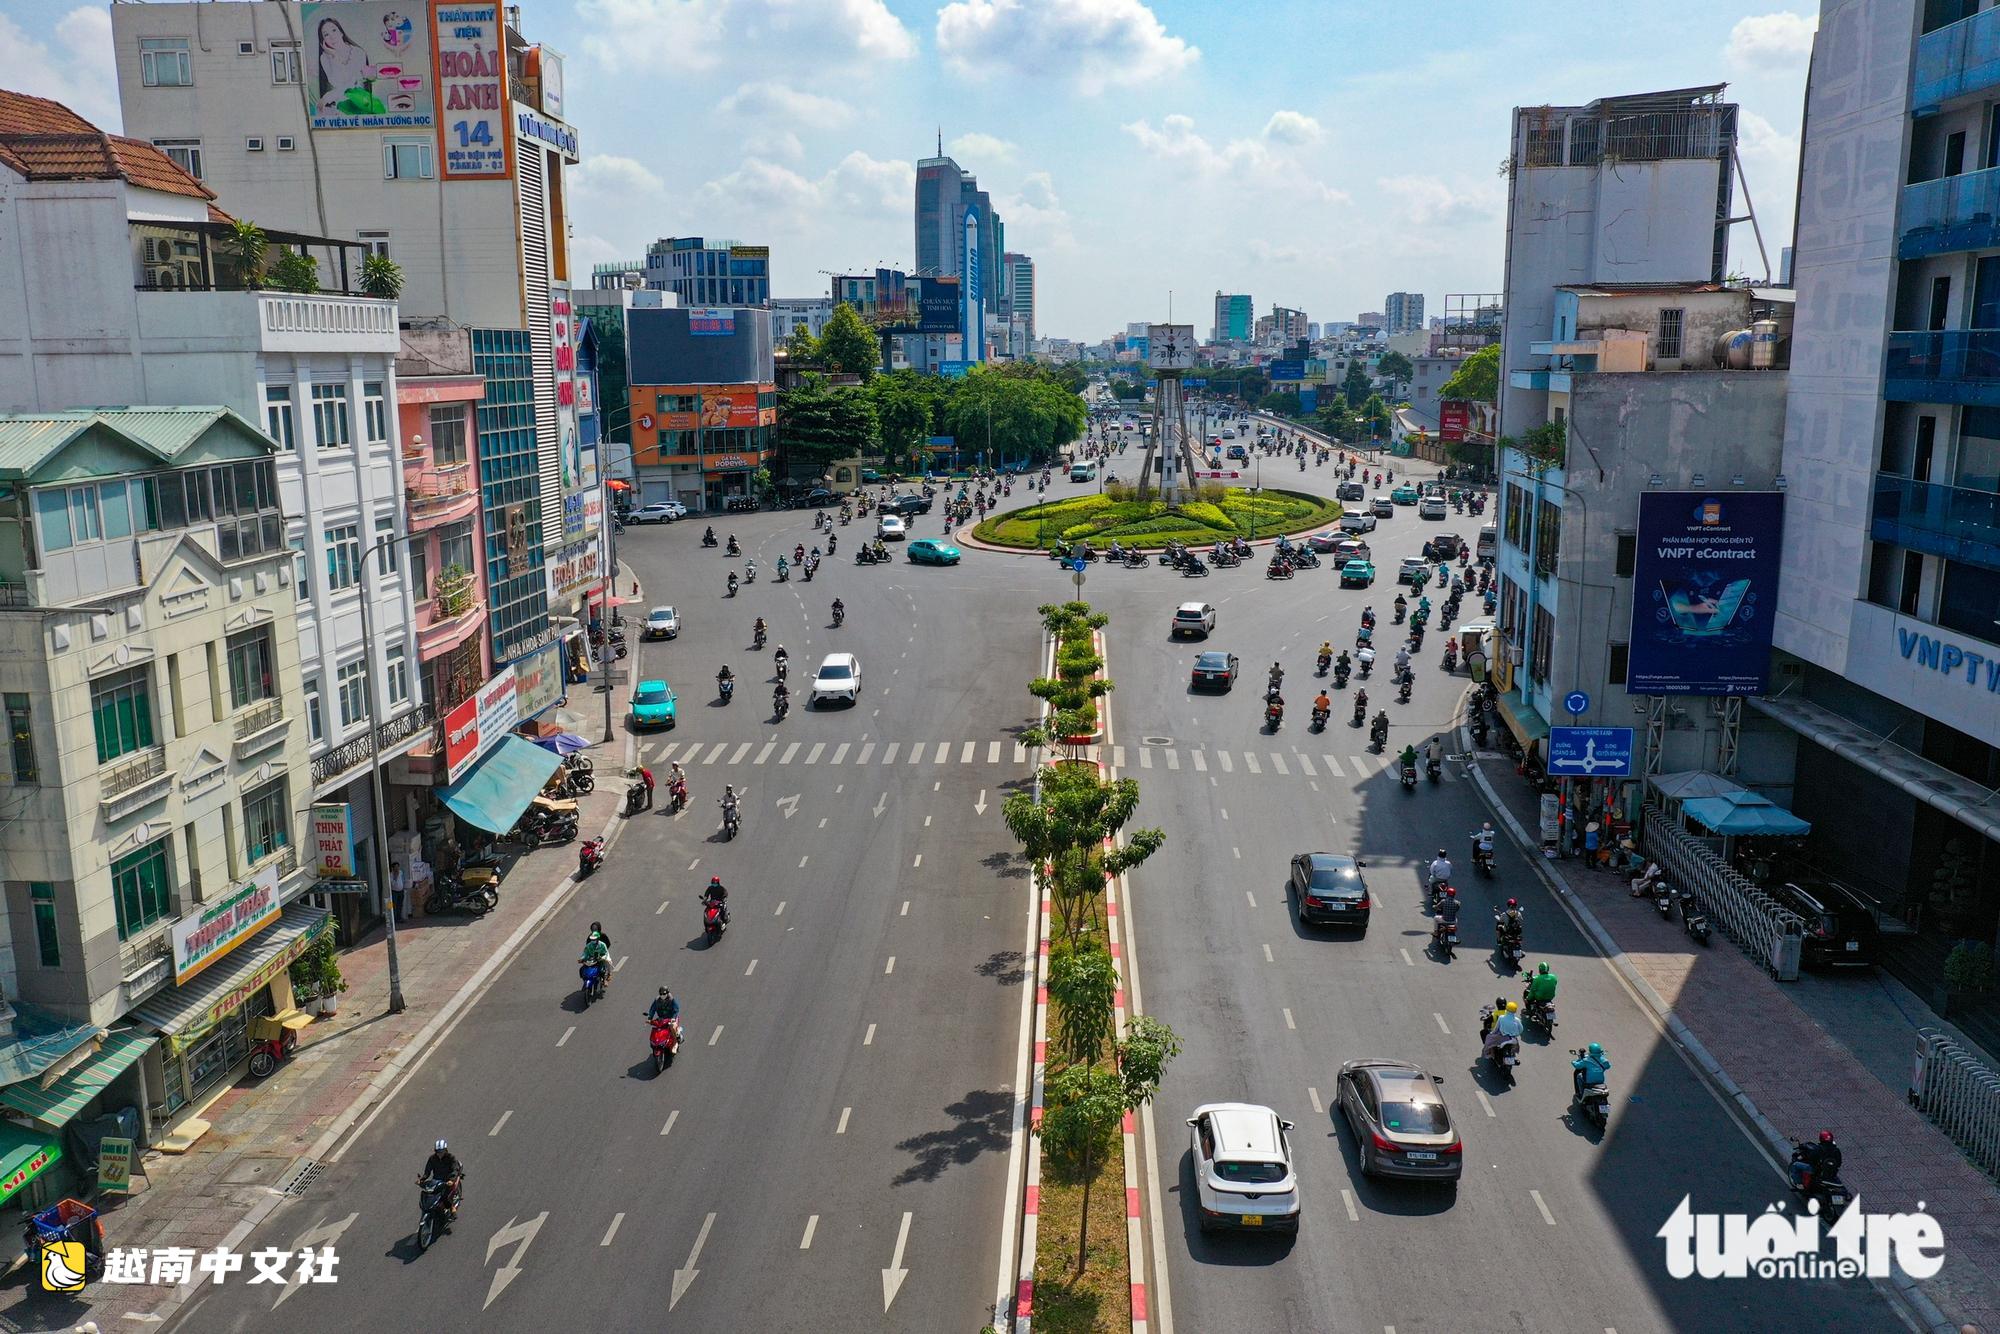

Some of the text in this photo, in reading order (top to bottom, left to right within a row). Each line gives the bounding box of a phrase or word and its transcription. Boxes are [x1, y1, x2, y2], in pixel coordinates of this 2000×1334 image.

[454, 26, 482, 40] VIỆN
[441, 43, 499, 78] HOÀI
[447, 84, 499, 110] ANH
[315, 119, 326, 127] MỸ
[329, 118, 347, 127] VIỆN
[414, 116, 430, 125] HỌC
[454, 120, 493, 147] 14
[1658, 548, 1756, 559] VNPT eContract
[507, 643, 523, 660] NHA
[1898, 627, 1984, 685] VNPT
[315, 823, 344, 836] THỊNH
[319, 837, 343, 851] PHÁT
[325, 855, 341, 868] 62
